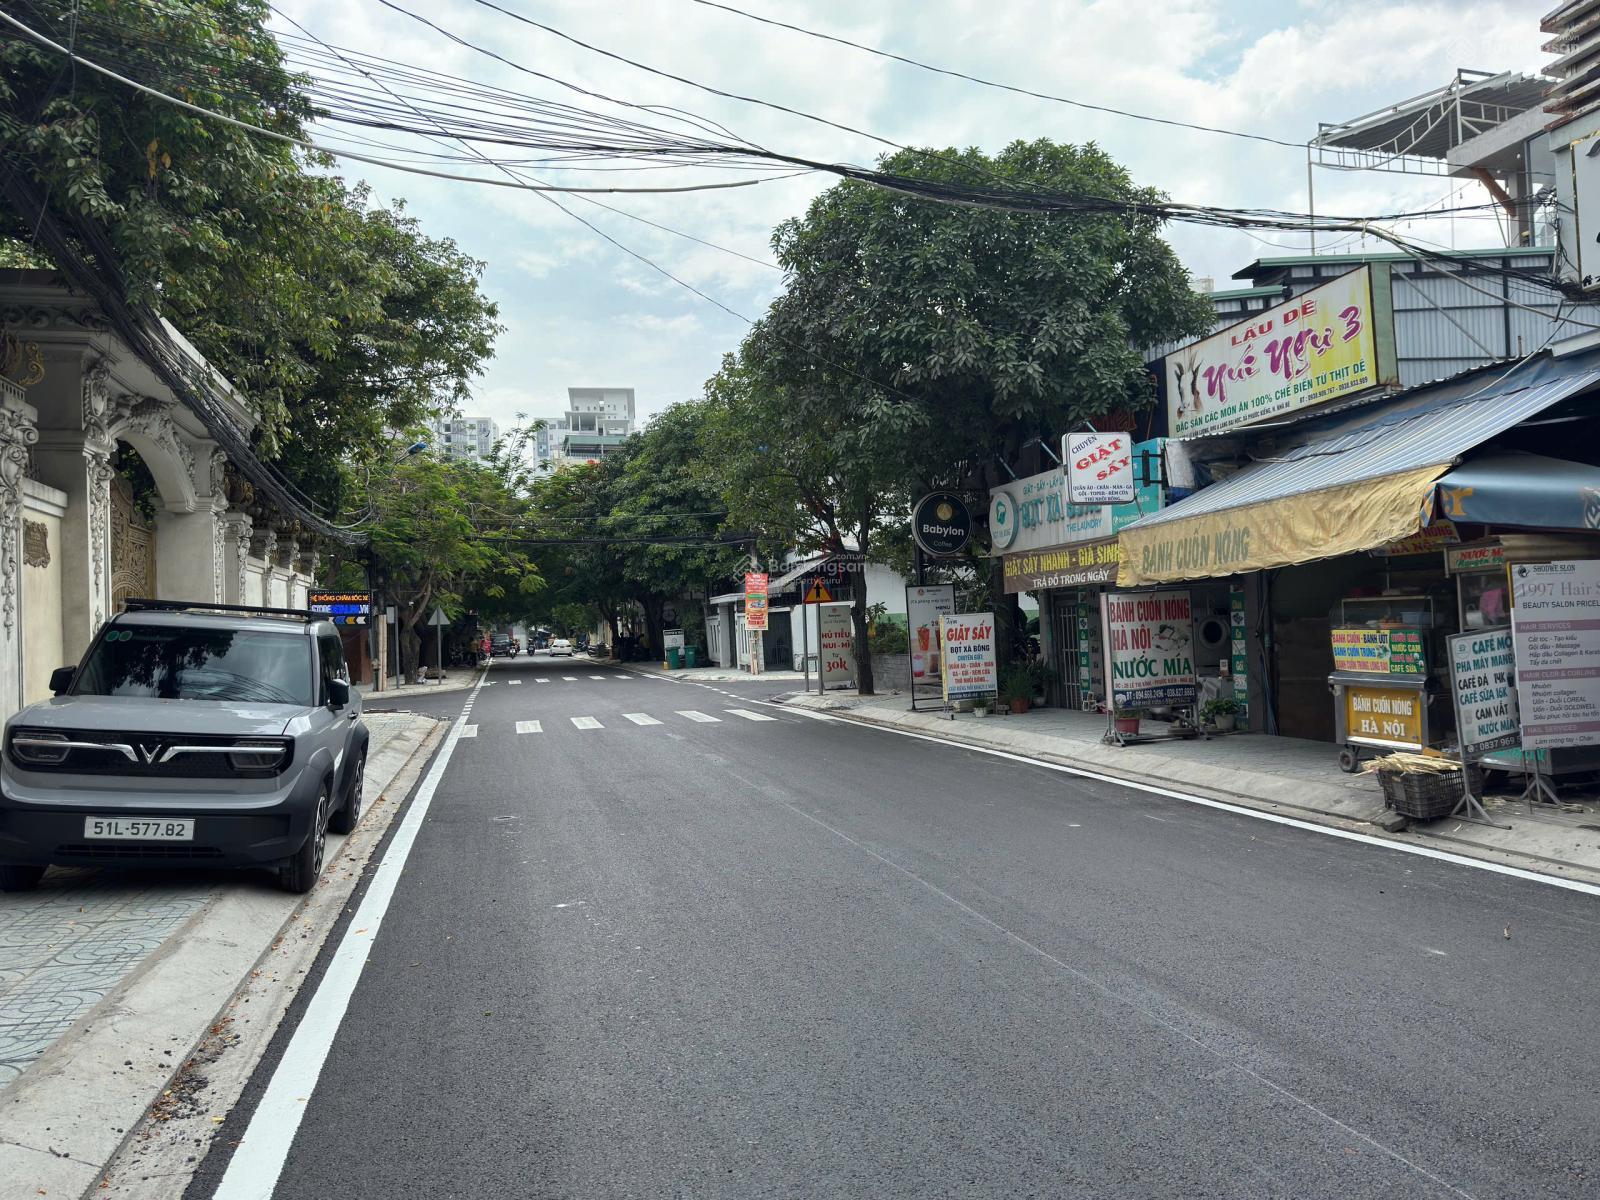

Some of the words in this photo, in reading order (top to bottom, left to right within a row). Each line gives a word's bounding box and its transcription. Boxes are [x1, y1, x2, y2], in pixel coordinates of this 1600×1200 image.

[1283, 299, 1317, 326] DÊ
[1338, 306, 1361, 343] 3
[1205, 410, 1219, 424] CÁC
[1220, 405, 1237, 419] MÓN
[1251, 394, 1273, 409] 100%
[1316, 372, 1327, 386] TỪ
[1330, 366, 1350, 382] THỊT
[1072, 435, 1098, 454] CHUYÊN
[1076, 439, 1122, 470] GIẶT
[1097, 456, 1131, 481] SẤY
[922, 524, 965, 538] Babylon
[1004, 557, 1021, 580] GIẶT
[1023, 553, 1038, 575] SẤY
[1040, 551, 1070, 572] NHANH
[1078, 545, 1095, 568] GIÁ
[1142, 535, 1174, 576] BÁNH
[1033, 574, 1047, 588] TRẢ
[1048, 572, 1058, 587] ĐỒ
[1060, 571, 1086, 585] TRONG
[1087, 567, 1110, 581] NGÀY
[1521, 582, 1555, 597] 1997
[1560, 580, 1593, 596] Hair
[1109, 597, 1135, 623] BÁNH
[1136, 592, 1162, 622] CUỐN
[1164, 594, 1190, 621] NÓNG
[1522, 601, 1550, 609] BEAUTY
[1551, 600, 1575, 608] SALON
[946, 624, 971, 645] GIẶT
[972, 620, 992, 641] SẤY
[1112, 625, 1129, 651] HÀ
[1131, 624, 1152, 653] NỘI
[1472, 635, 1496, 655] CAFÉ
[826, 657, 848, 672] 30k
[1112, 655, 1158, 680] NƯỚC
[1163, 652, 1193, 677] MÍA
[1456, 661, 1472, 673] PHA
[1473, 655, 1489, 671] MÁY
[1491, 653, 1514, 668] MANG
[1458, 676, 1476, 691] CAFÉ
[1477, 672, 1489, 688] ĐÁ
[1494, 671, 1506, 685] 14K
[1353, 694, 1372, 712] BÁNH
[1372, 695, 1391, 714] CUỐN
[1391, 697, 1412, 716] NÓNG
[1460, 690, 1478, 706] CAFÉ
[1479, 687, 1495, 702] SỮA
[1475, 706, 1493, 721] CAM
[1361, 716, 1379, 733] HÀ
[1382, 719, 1406, 738] NỘI
[1478, 720, 1499, 737] NƯỚC
[1500, 717, 1515, 732] MÍA
[1479, 739, 1499, 752] 0837
[1500, 736, 1516, 748] 969
[94, 821, 185, 837] 51L-577.82
